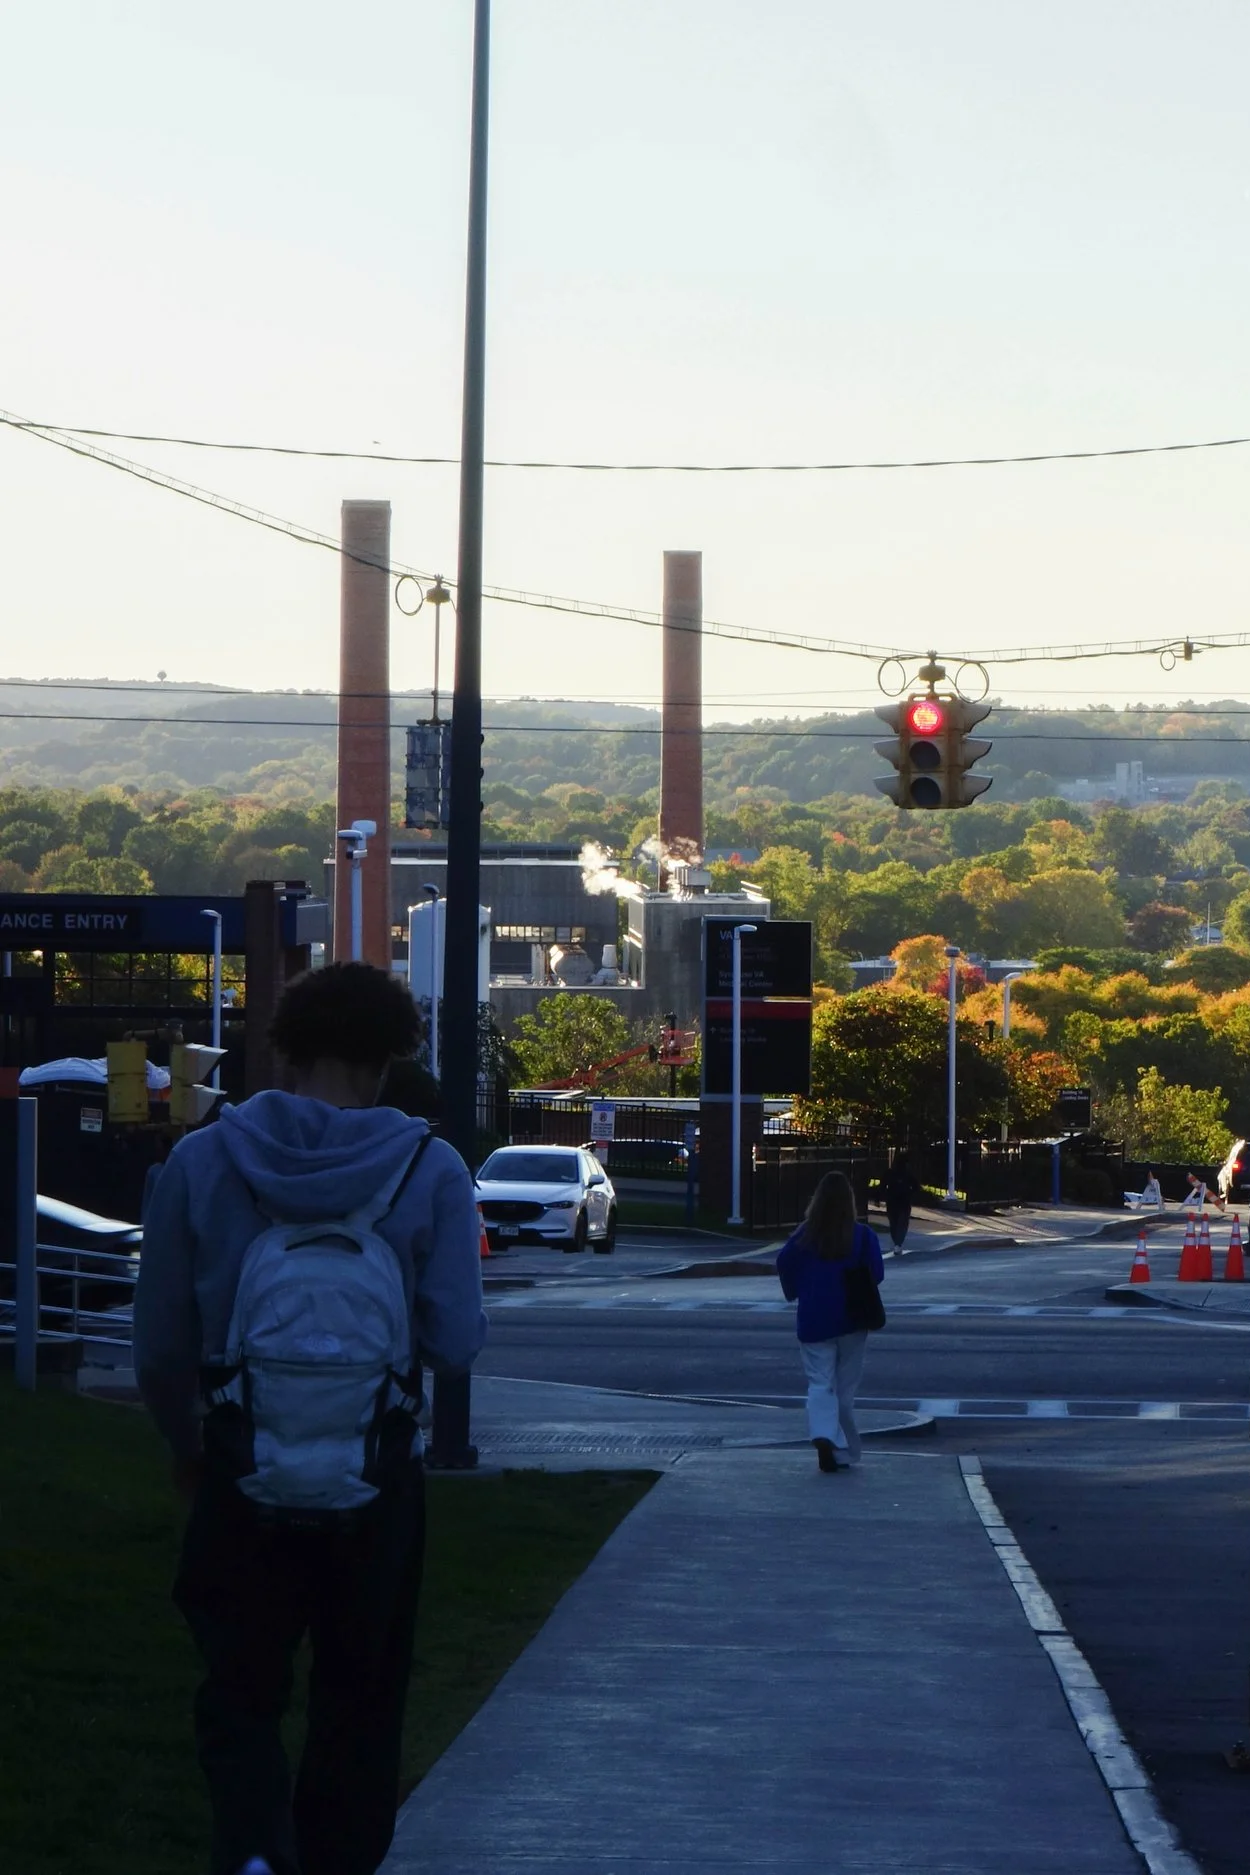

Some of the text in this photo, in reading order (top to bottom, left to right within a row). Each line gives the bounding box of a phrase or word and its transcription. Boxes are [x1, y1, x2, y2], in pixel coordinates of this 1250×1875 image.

[0, 912, 128, 930] ANCE ENTRY
[719, 929, 733, 941] VA
